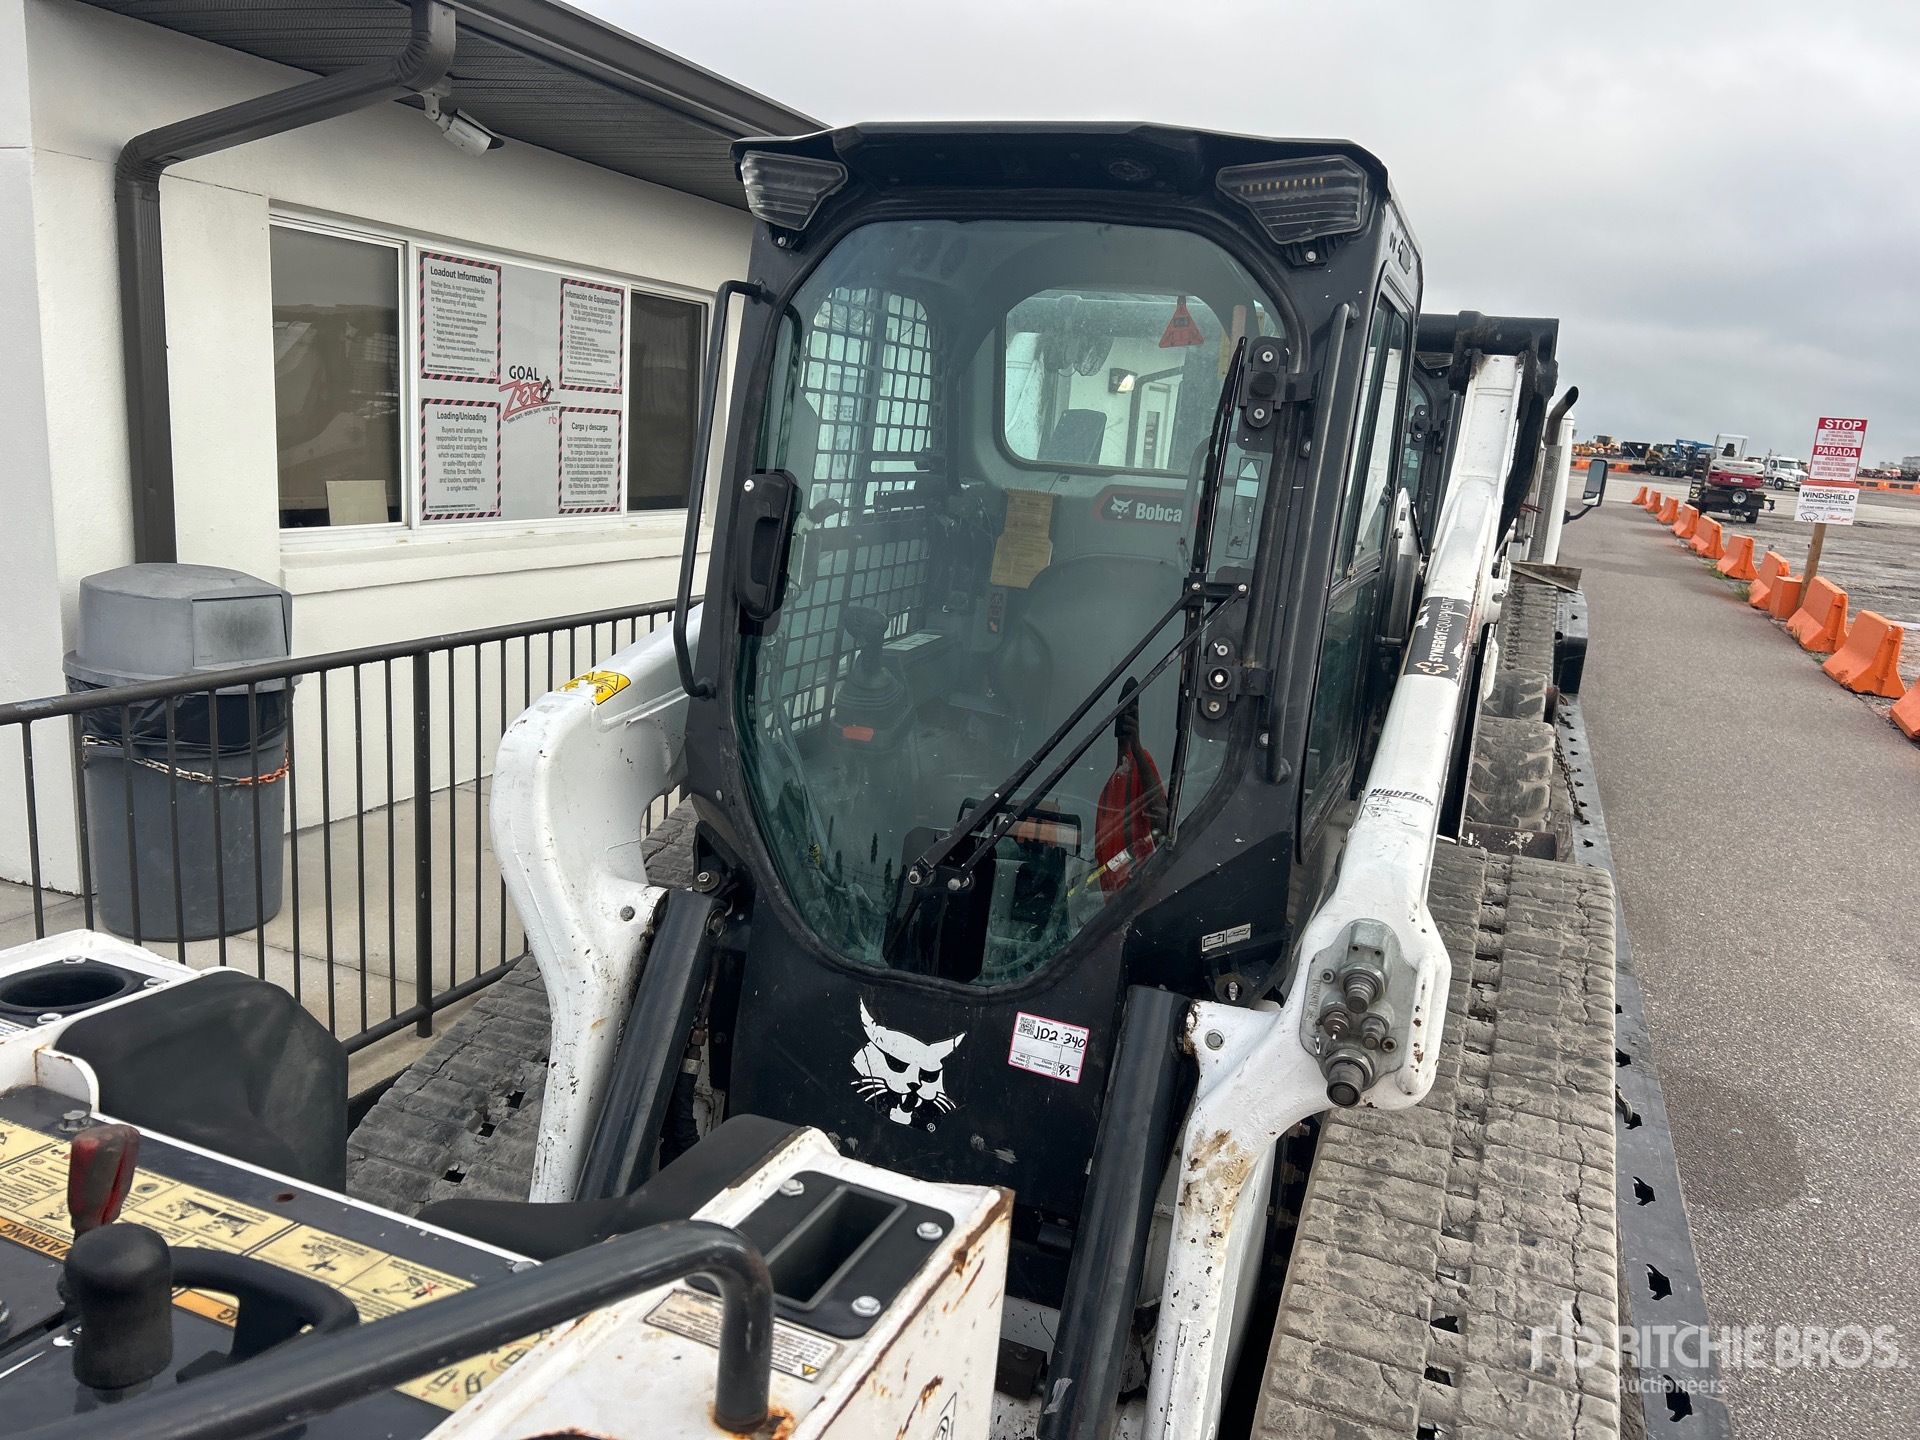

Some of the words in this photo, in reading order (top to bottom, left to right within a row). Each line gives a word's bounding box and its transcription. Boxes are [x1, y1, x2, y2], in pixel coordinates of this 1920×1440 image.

[431, 266, 456, 278] Loadout
[458, 271, 492, 284] Information
[509, 365, 540, 381] GOAL
[572, 422, 584, 431] Carga
[1825, 420, 1862, 430] STOP
[1817, 447, 1857, 456] PARADA
[1802, 492, 1855, 500] WINDSHIELD
[1135, 502, 1182, 522] Bobca
